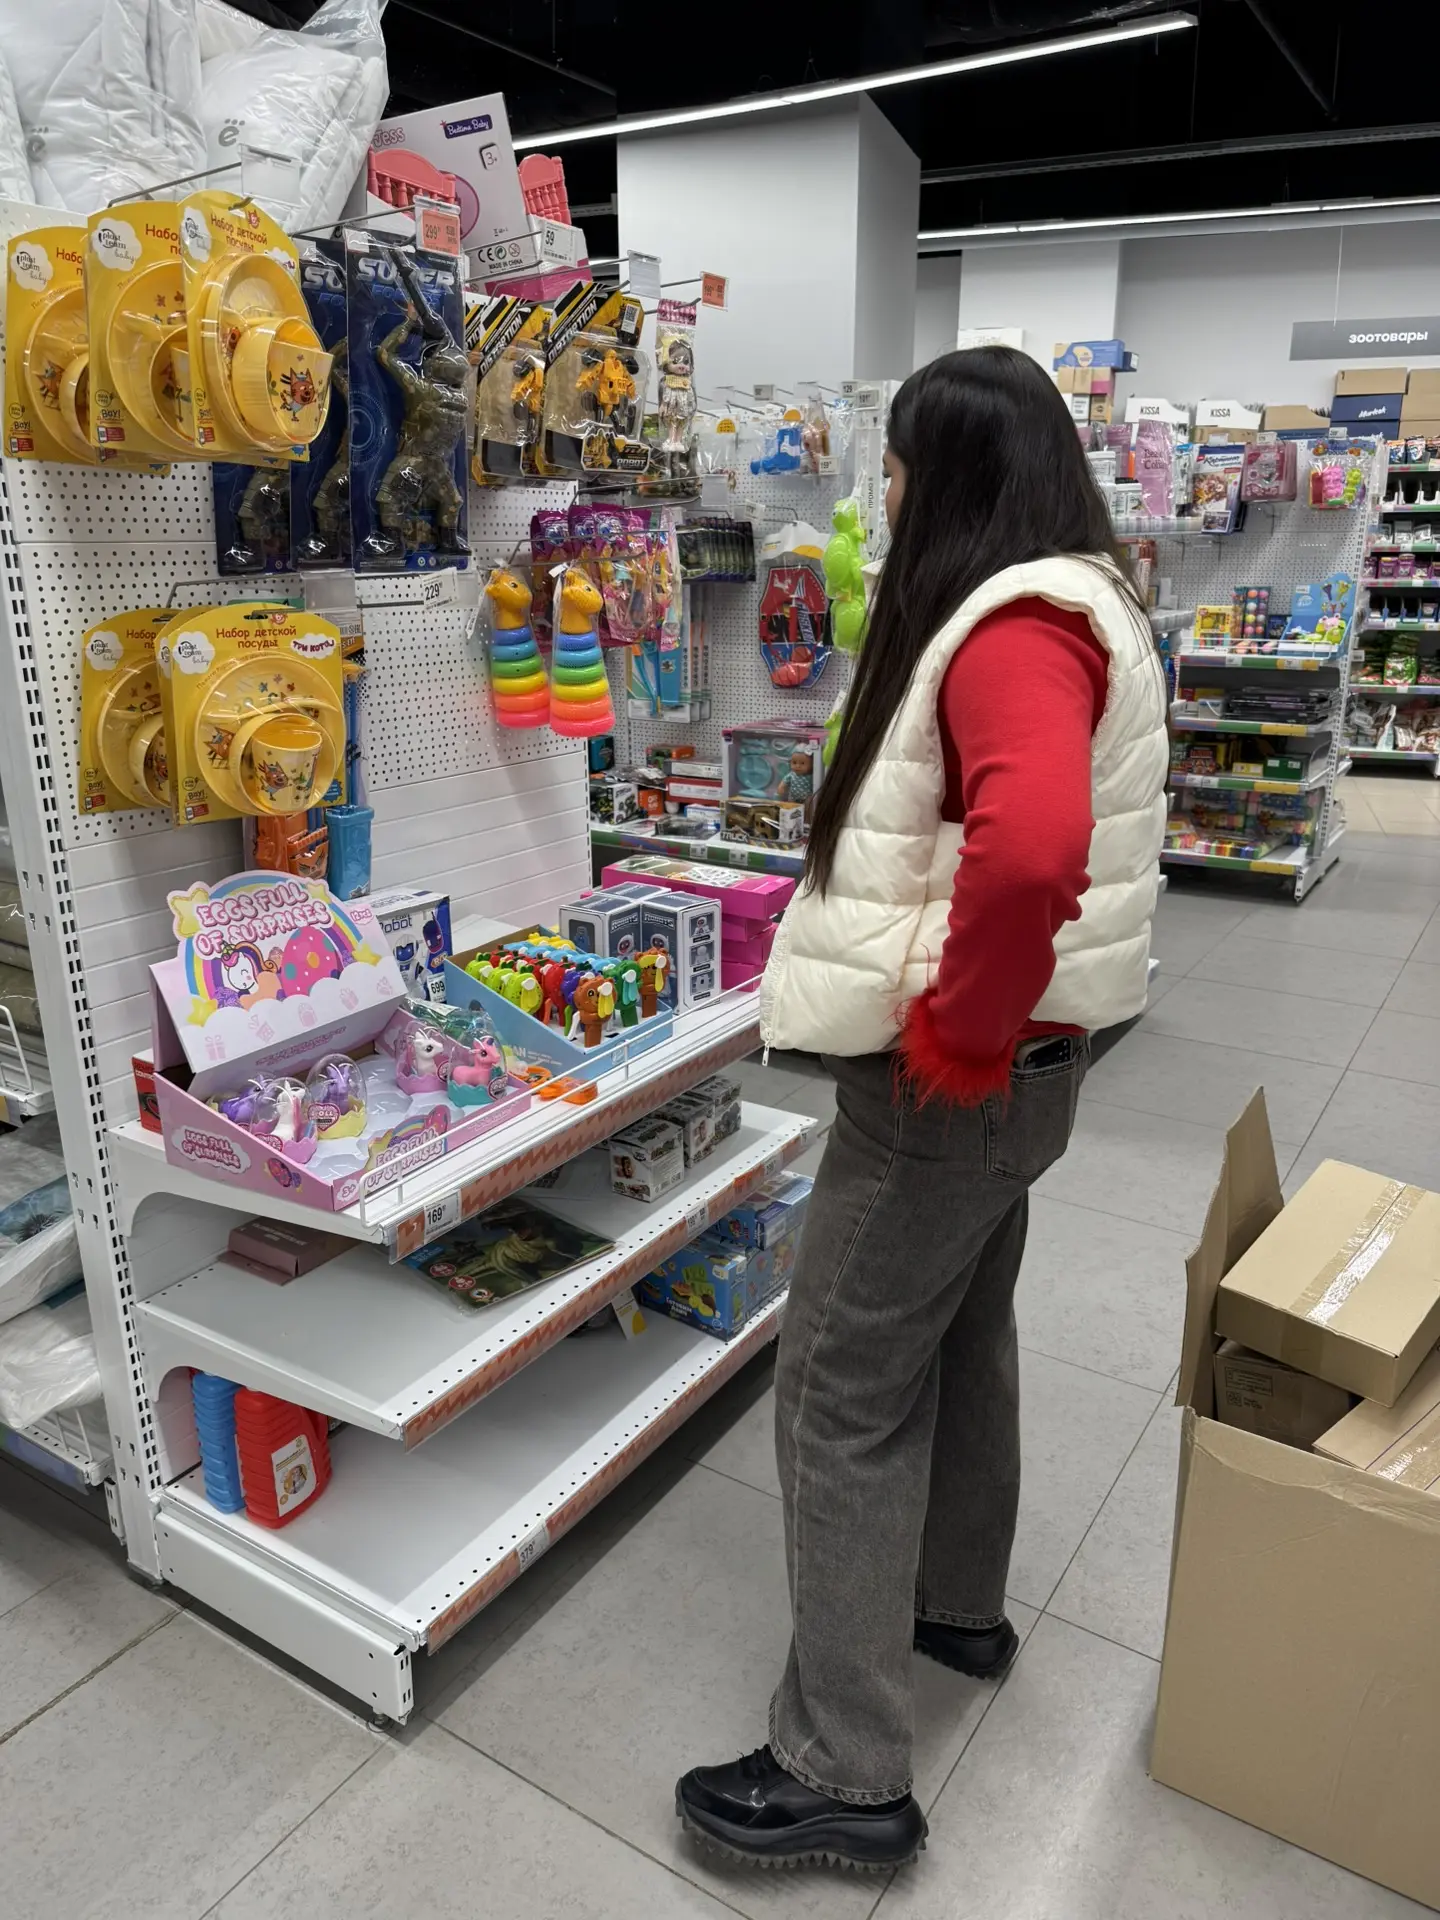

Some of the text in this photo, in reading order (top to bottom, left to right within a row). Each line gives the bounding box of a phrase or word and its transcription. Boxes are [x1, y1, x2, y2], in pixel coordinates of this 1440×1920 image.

[472, 119, 489, 130] Baby
[145, 222, 181, 245] Набо
[210, 212, 235, 237] Набор
[236, 226, 268, 246] детской
[508, 258, 523, 267] CHINA
[1348, 331, 1429, 344] зоотовары
[1139, 405, 1160, 415] KISSA
[1210, 408, 1231, 417] KISSA
[425, 583, 440, 601] 229
[216, 625, 297, 640] Набор детской
[238, 639, 278, 651] посуды
[721, 831, 748, 843] TRUCK
[197, 881, 308, 927] EGGS FULL
[195, 900, 332, 956] OF SURPRISES
[431, 981, 446, 994] 699
[184, 1130, 234, 1153] EGGS FULL
[195, 1145, 241, 1169] SURPRISES
[342, 1183, 356, 1197] 3+
[427, 1203, 443, 1225] 169
